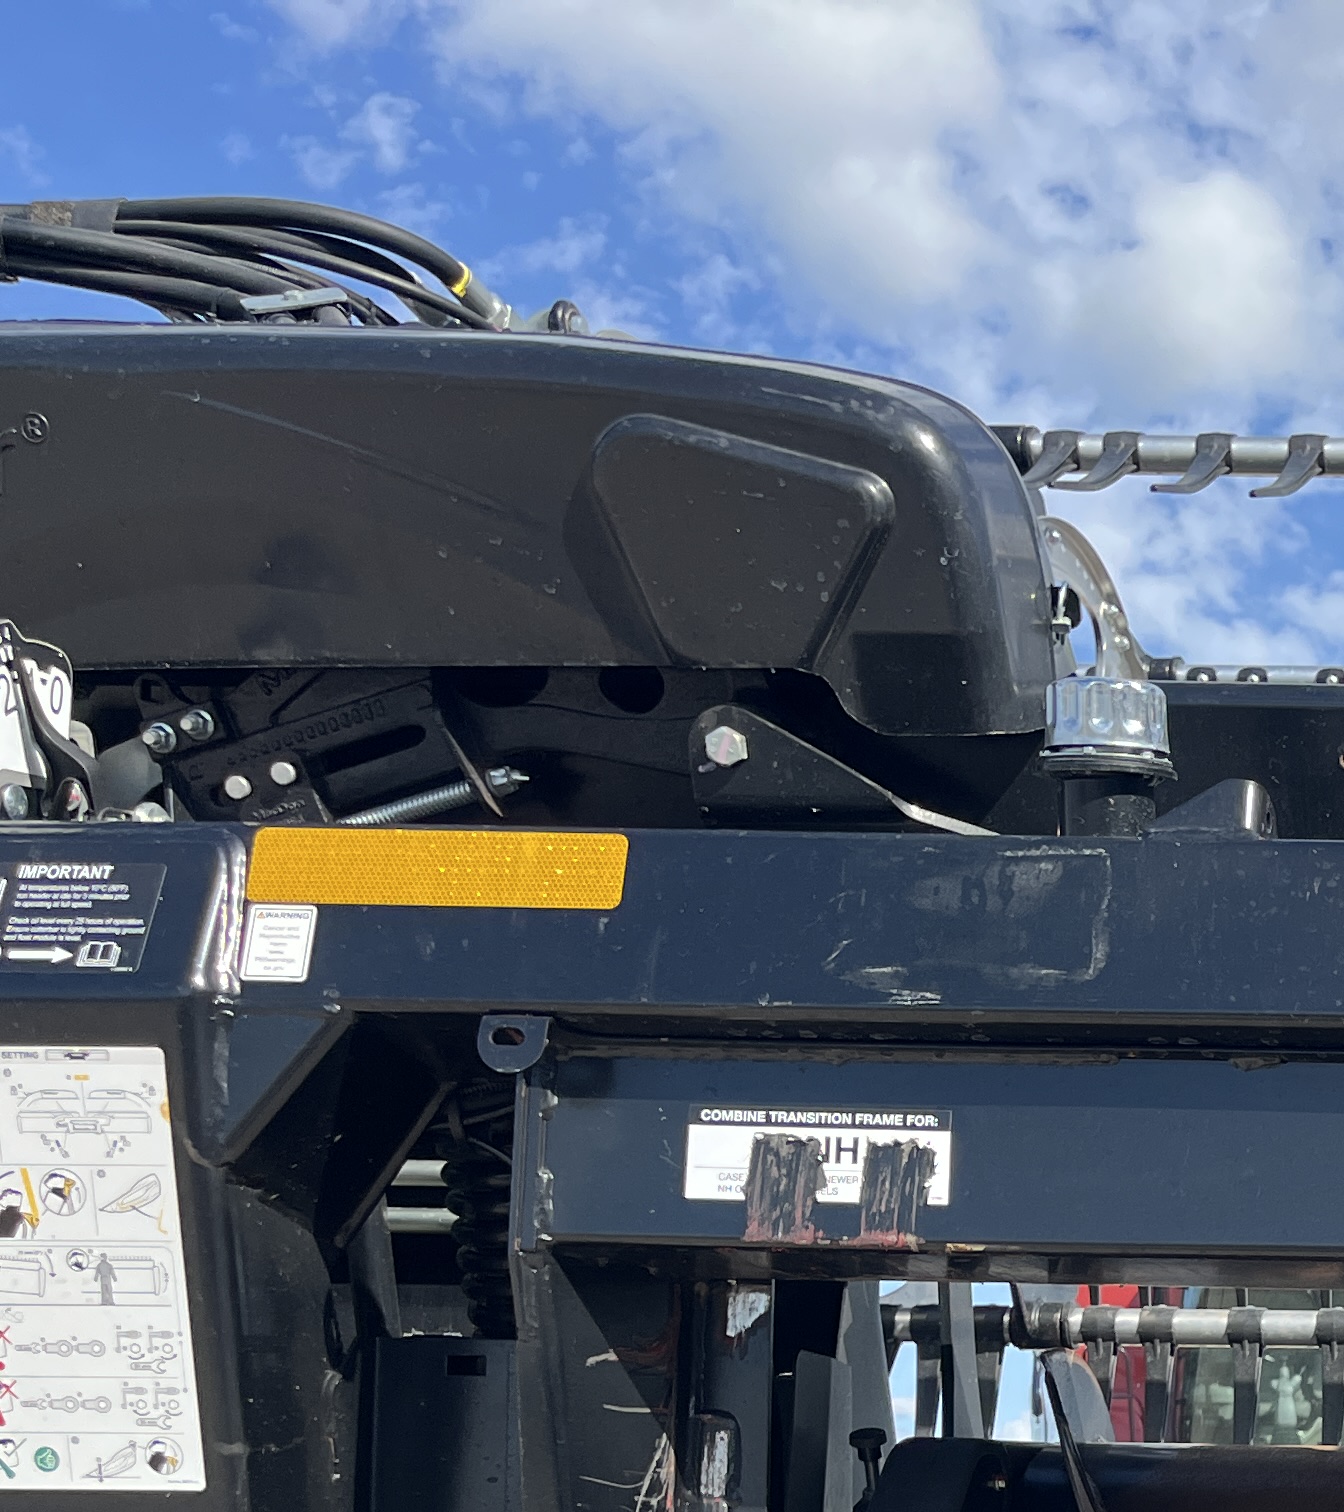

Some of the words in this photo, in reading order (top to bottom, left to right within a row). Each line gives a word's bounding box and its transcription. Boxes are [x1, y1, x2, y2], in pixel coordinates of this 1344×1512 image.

[18, 865, 114, 879] IMPORTANT
[1, 1051, 39, 1059] SETTING
[700, 1109, 766, 1123] COMBINE
[769, 1111, 852, 1125] TRANSITION
[855, 1113, 903, 1126] FRAME
[906, 1114, 939, 1127] FOR:
[718, 1172, 744, 1182] CASE
[717, 1184, 733, 1192] NH
